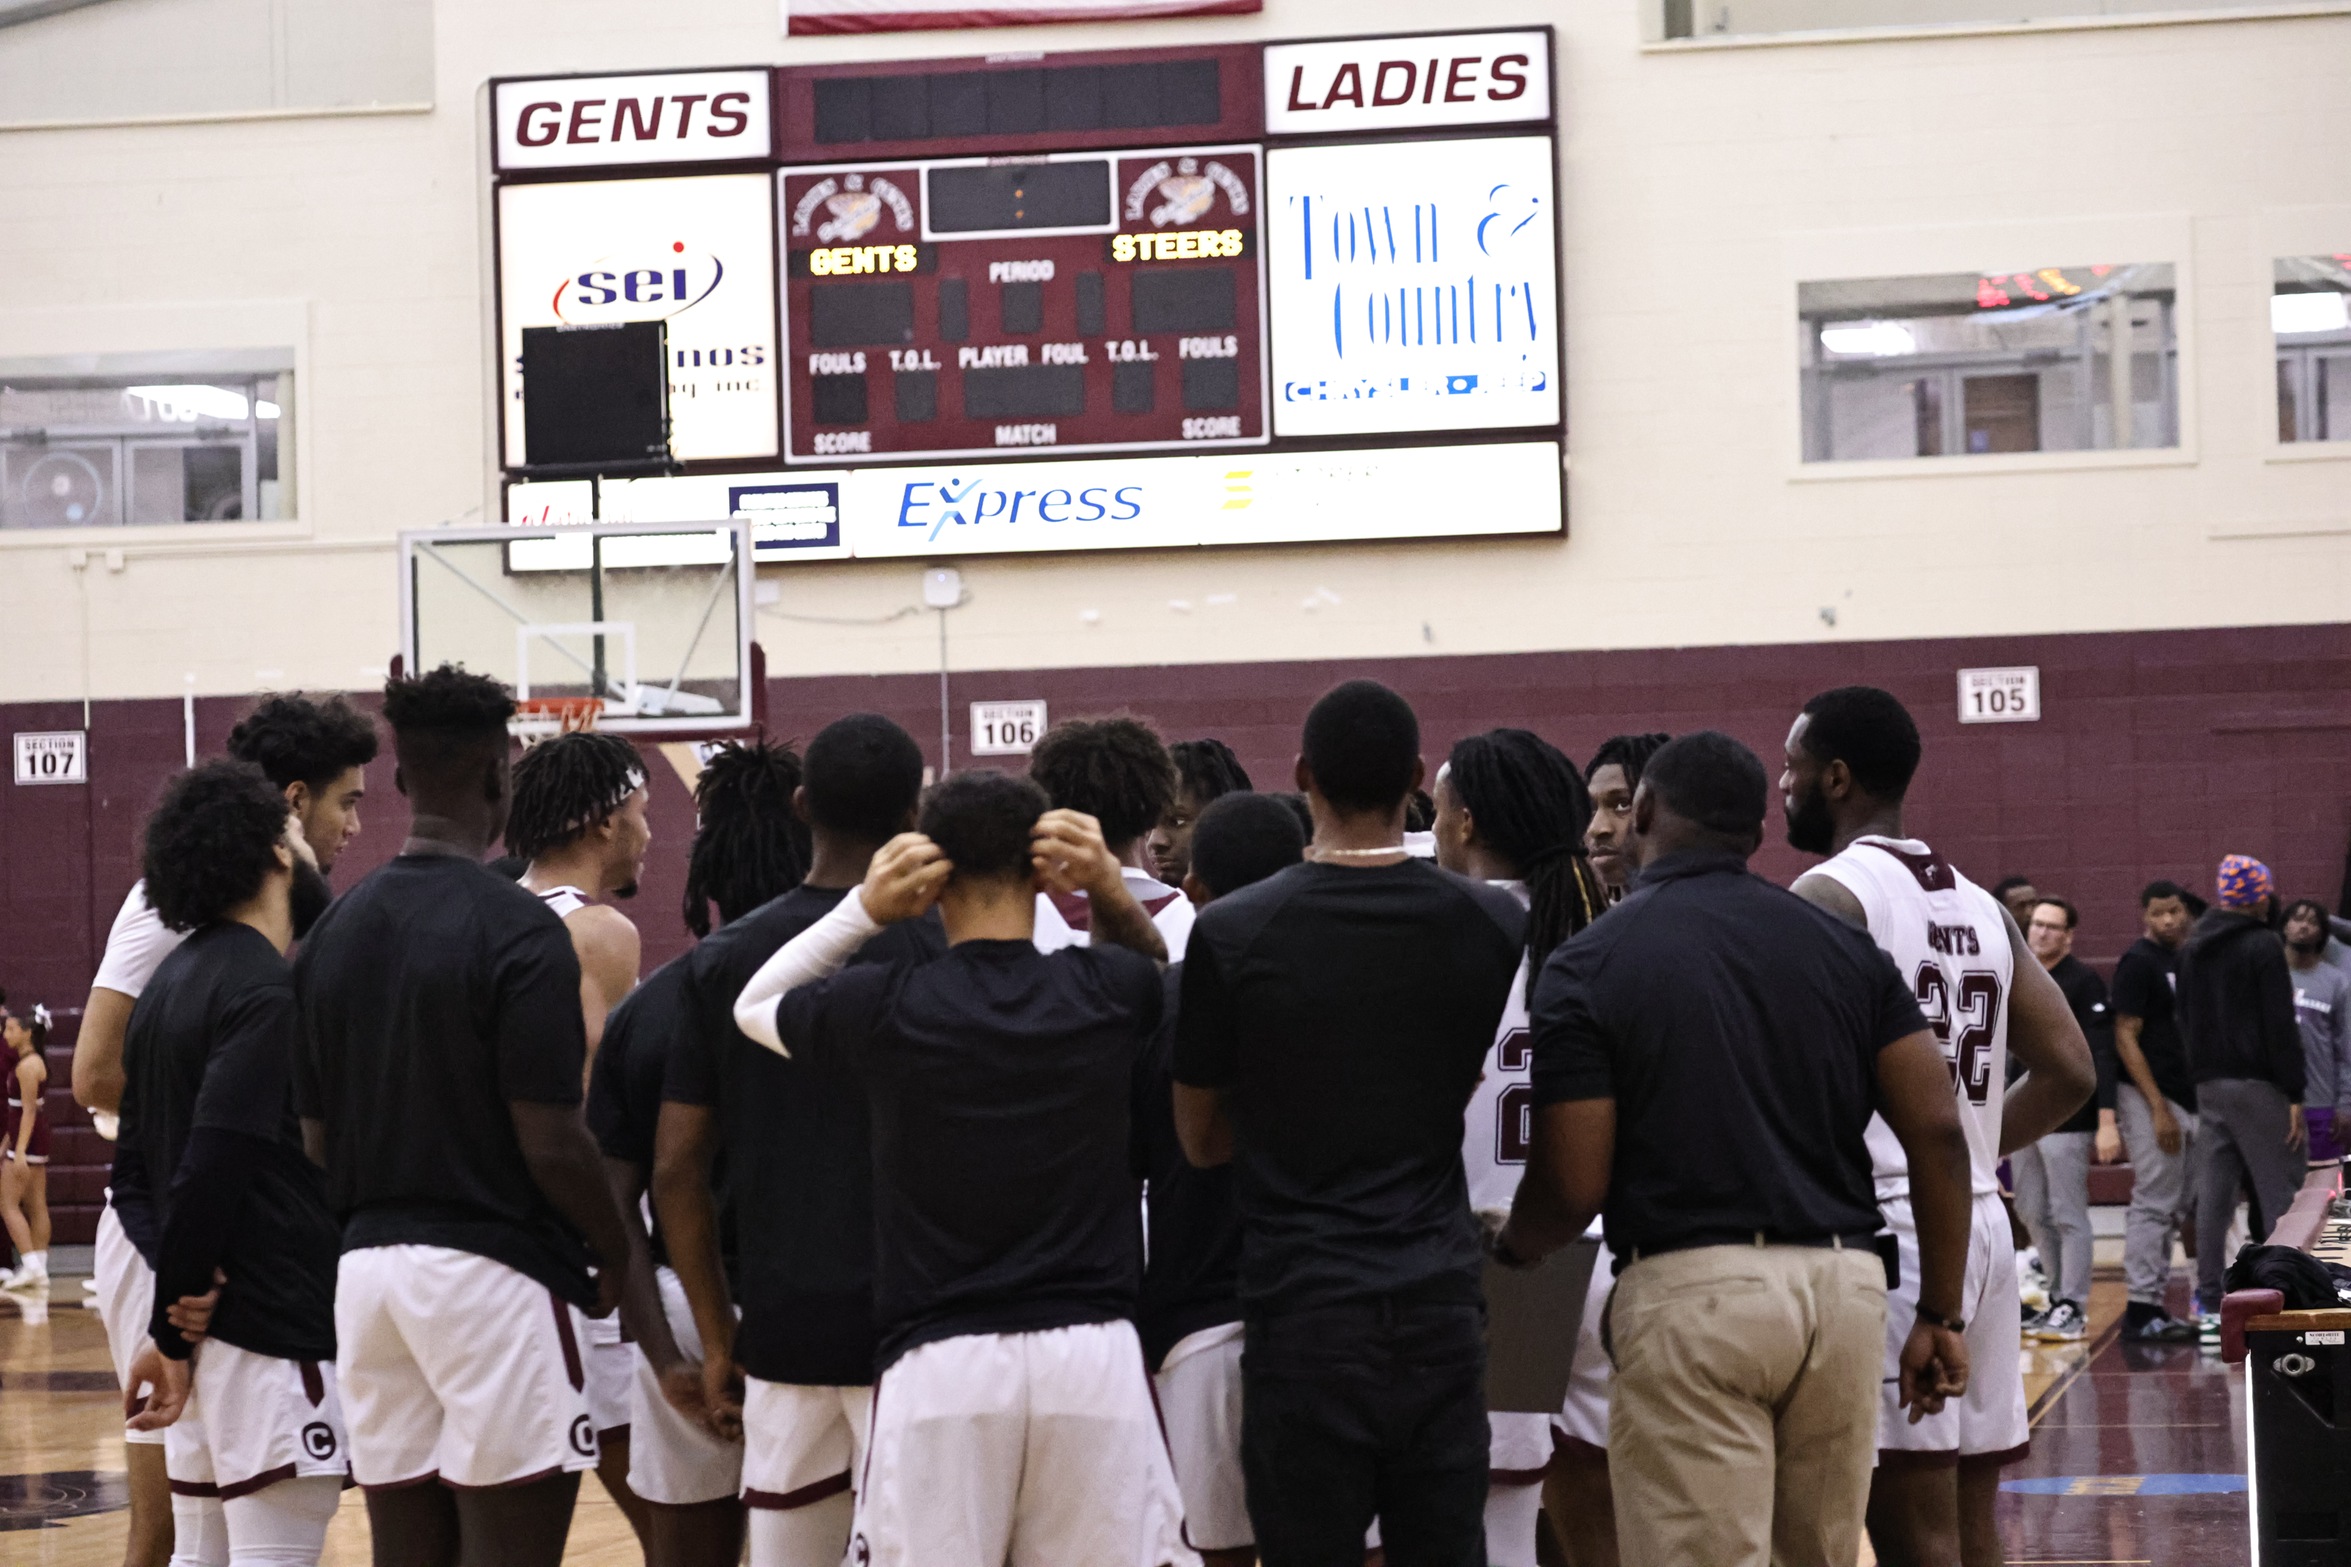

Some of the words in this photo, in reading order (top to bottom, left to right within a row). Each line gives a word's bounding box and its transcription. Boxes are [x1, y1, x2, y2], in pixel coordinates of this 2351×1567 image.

[1286, 54, 1531, 112] LADIES
[515, 91, 751, 148] GENTS
[1112, 229, 1244, 262] STEERS
[1290, 195, 1438, 281] Town
[810, 245, 917, 276] GENTS
[989, 259, 1055, 283] PERIOD
[577, 241, 687, 305] sei
[959, 344, 1030, 369] PLAYER
[1105, 339, 1159, 362] T.O.L.
[1179, 336, 1238, 359] FOULS
[809, 352, 867, 375] FOULS
[888, 349, 942, 371] T.O.L.
[995, 423, 1057, 446] MATCH
[1182, 416, 1241, 440] SCORE
[814, 431, 872, 455] SCORE
[1972, 688, 2025, 713] 105
[984, 722, 1034, 745] 106
[26, 752, 74, 777] 107
